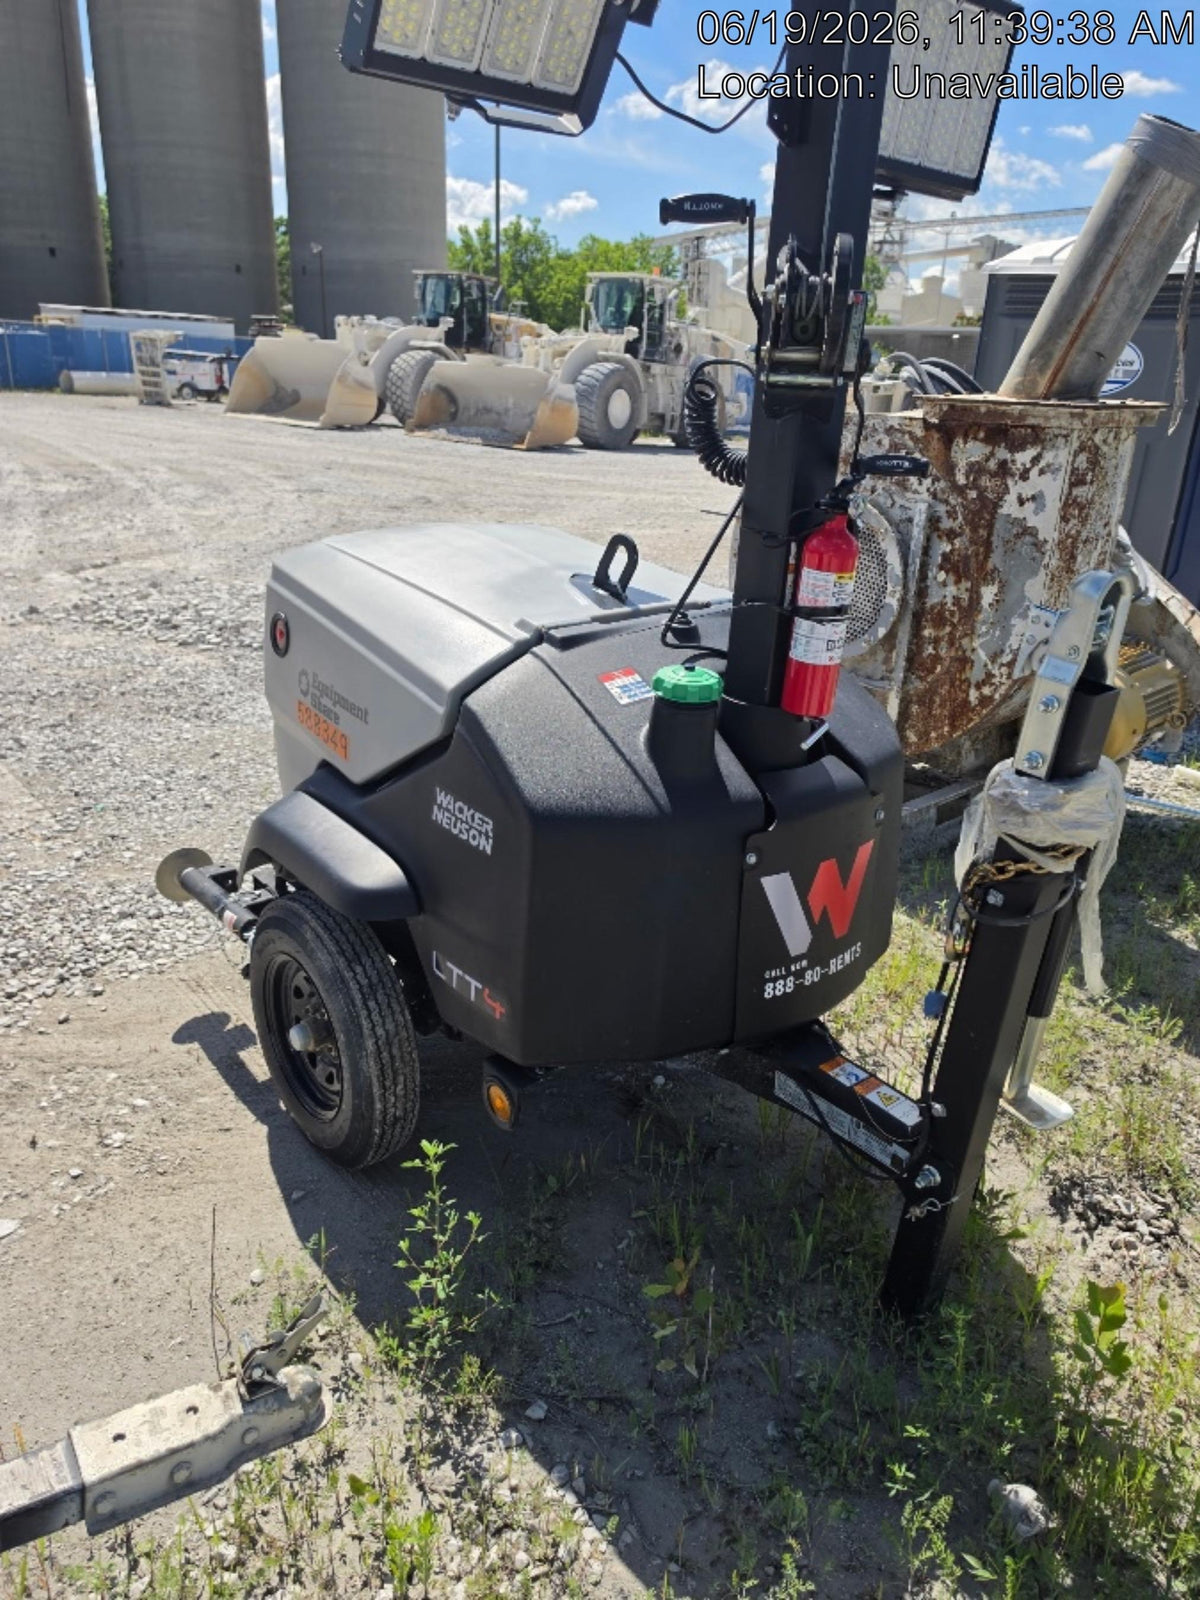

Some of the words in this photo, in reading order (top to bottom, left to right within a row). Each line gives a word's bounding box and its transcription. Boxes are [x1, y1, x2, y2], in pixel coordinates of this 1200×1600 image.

[310, 692, 340, 726] Share
[312, 672, 369, 725] Equipment
[432, 804, 493, 856] NEUSON
[436, 787, 493, 838] WACKER
